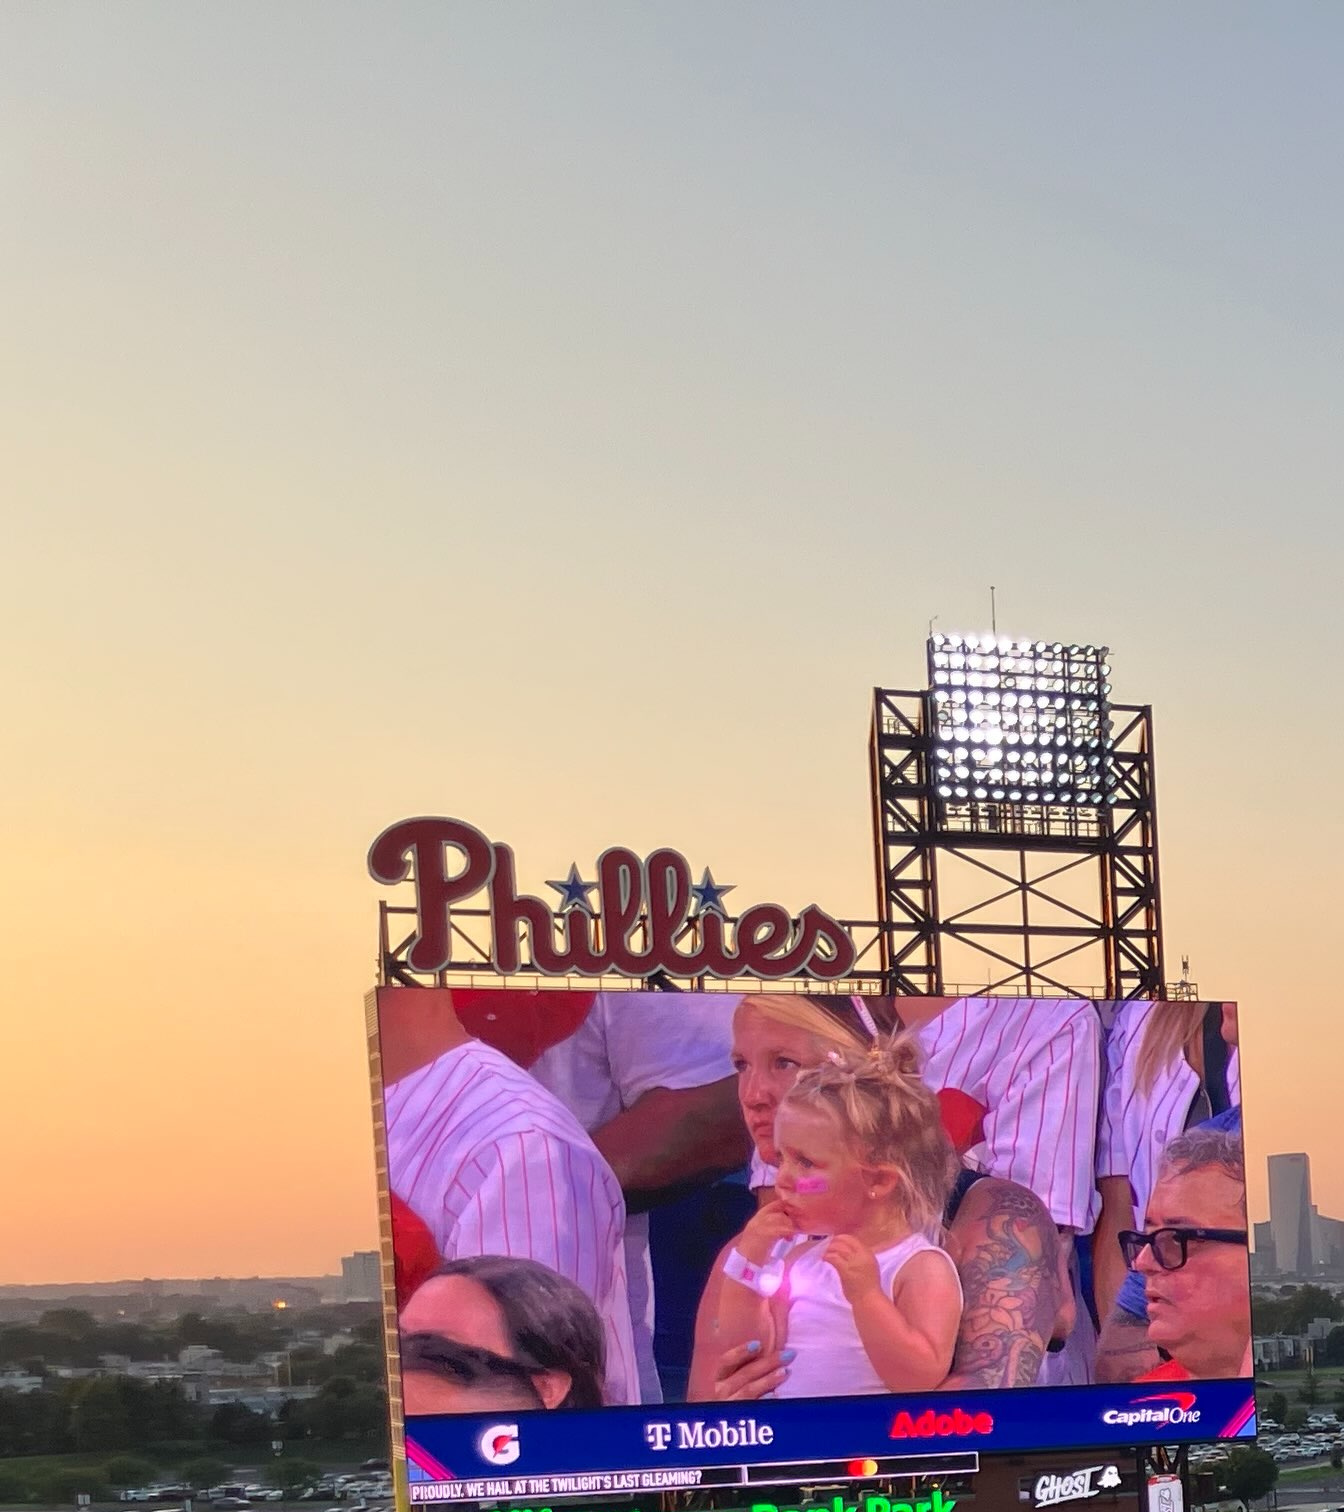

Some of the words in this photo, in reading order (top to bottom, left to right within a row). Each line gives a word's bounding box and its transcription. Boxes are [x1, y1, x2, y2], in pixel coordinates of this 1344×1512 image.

[367, 816, 857, 980] Phillies
[678, 1419, 774, 1449] Mobile
[889, 1408, 994, 1439] Adobe
[467, 1481, 485, 1496] WE
[486, 1480, 512, 1496] HAIL
[514, 1479, 527, 1494] AT
[529, 1477, 550, 1493] THE
[551, 1474, 612, 1493] TWILIGHT'S
[613, 1473, 640, 1489] LAST
[642, 1470, 703, 1488] GLEAMING?
[1035, 1465, 1104, 1508] GHOST
